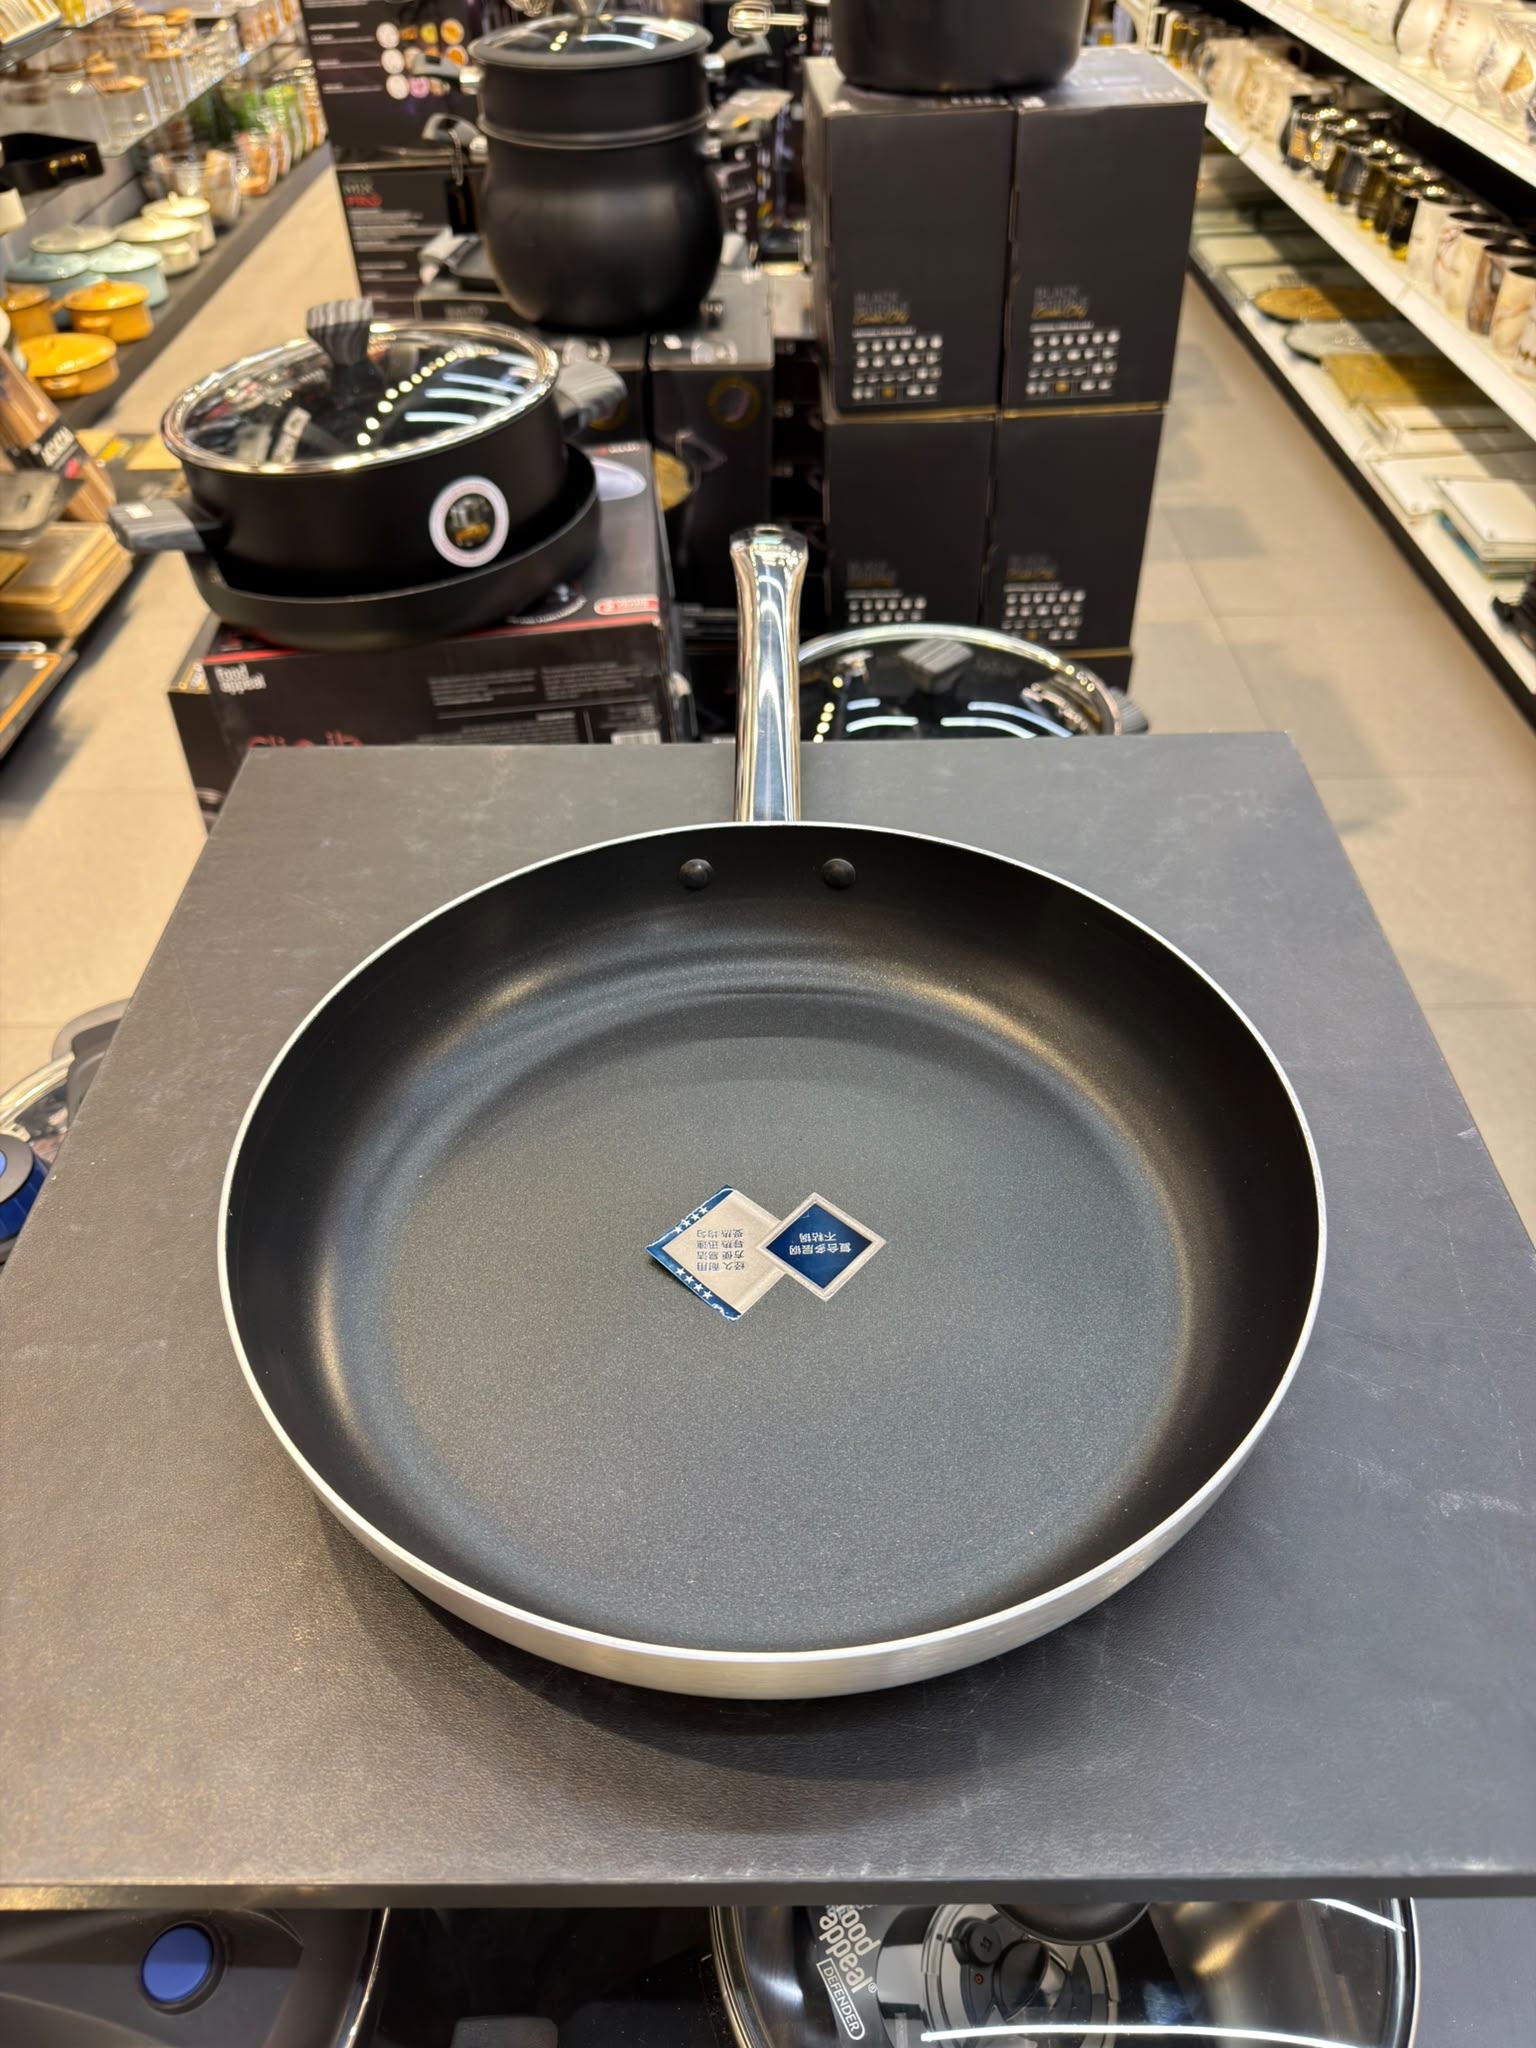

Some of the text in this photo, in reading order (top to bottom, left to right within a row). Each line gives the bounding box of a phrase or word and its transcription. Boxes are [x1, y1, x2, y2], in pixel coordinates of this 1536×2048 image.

[214, 662, 249, 682] food
[219, 673, 267, 696] appeal
[799, 1231, 837, 1243] 不粘锅
[789, 1242, 851, 1256] 复合多层钢
[823, 1966, 860, 2032] DEFENDER
